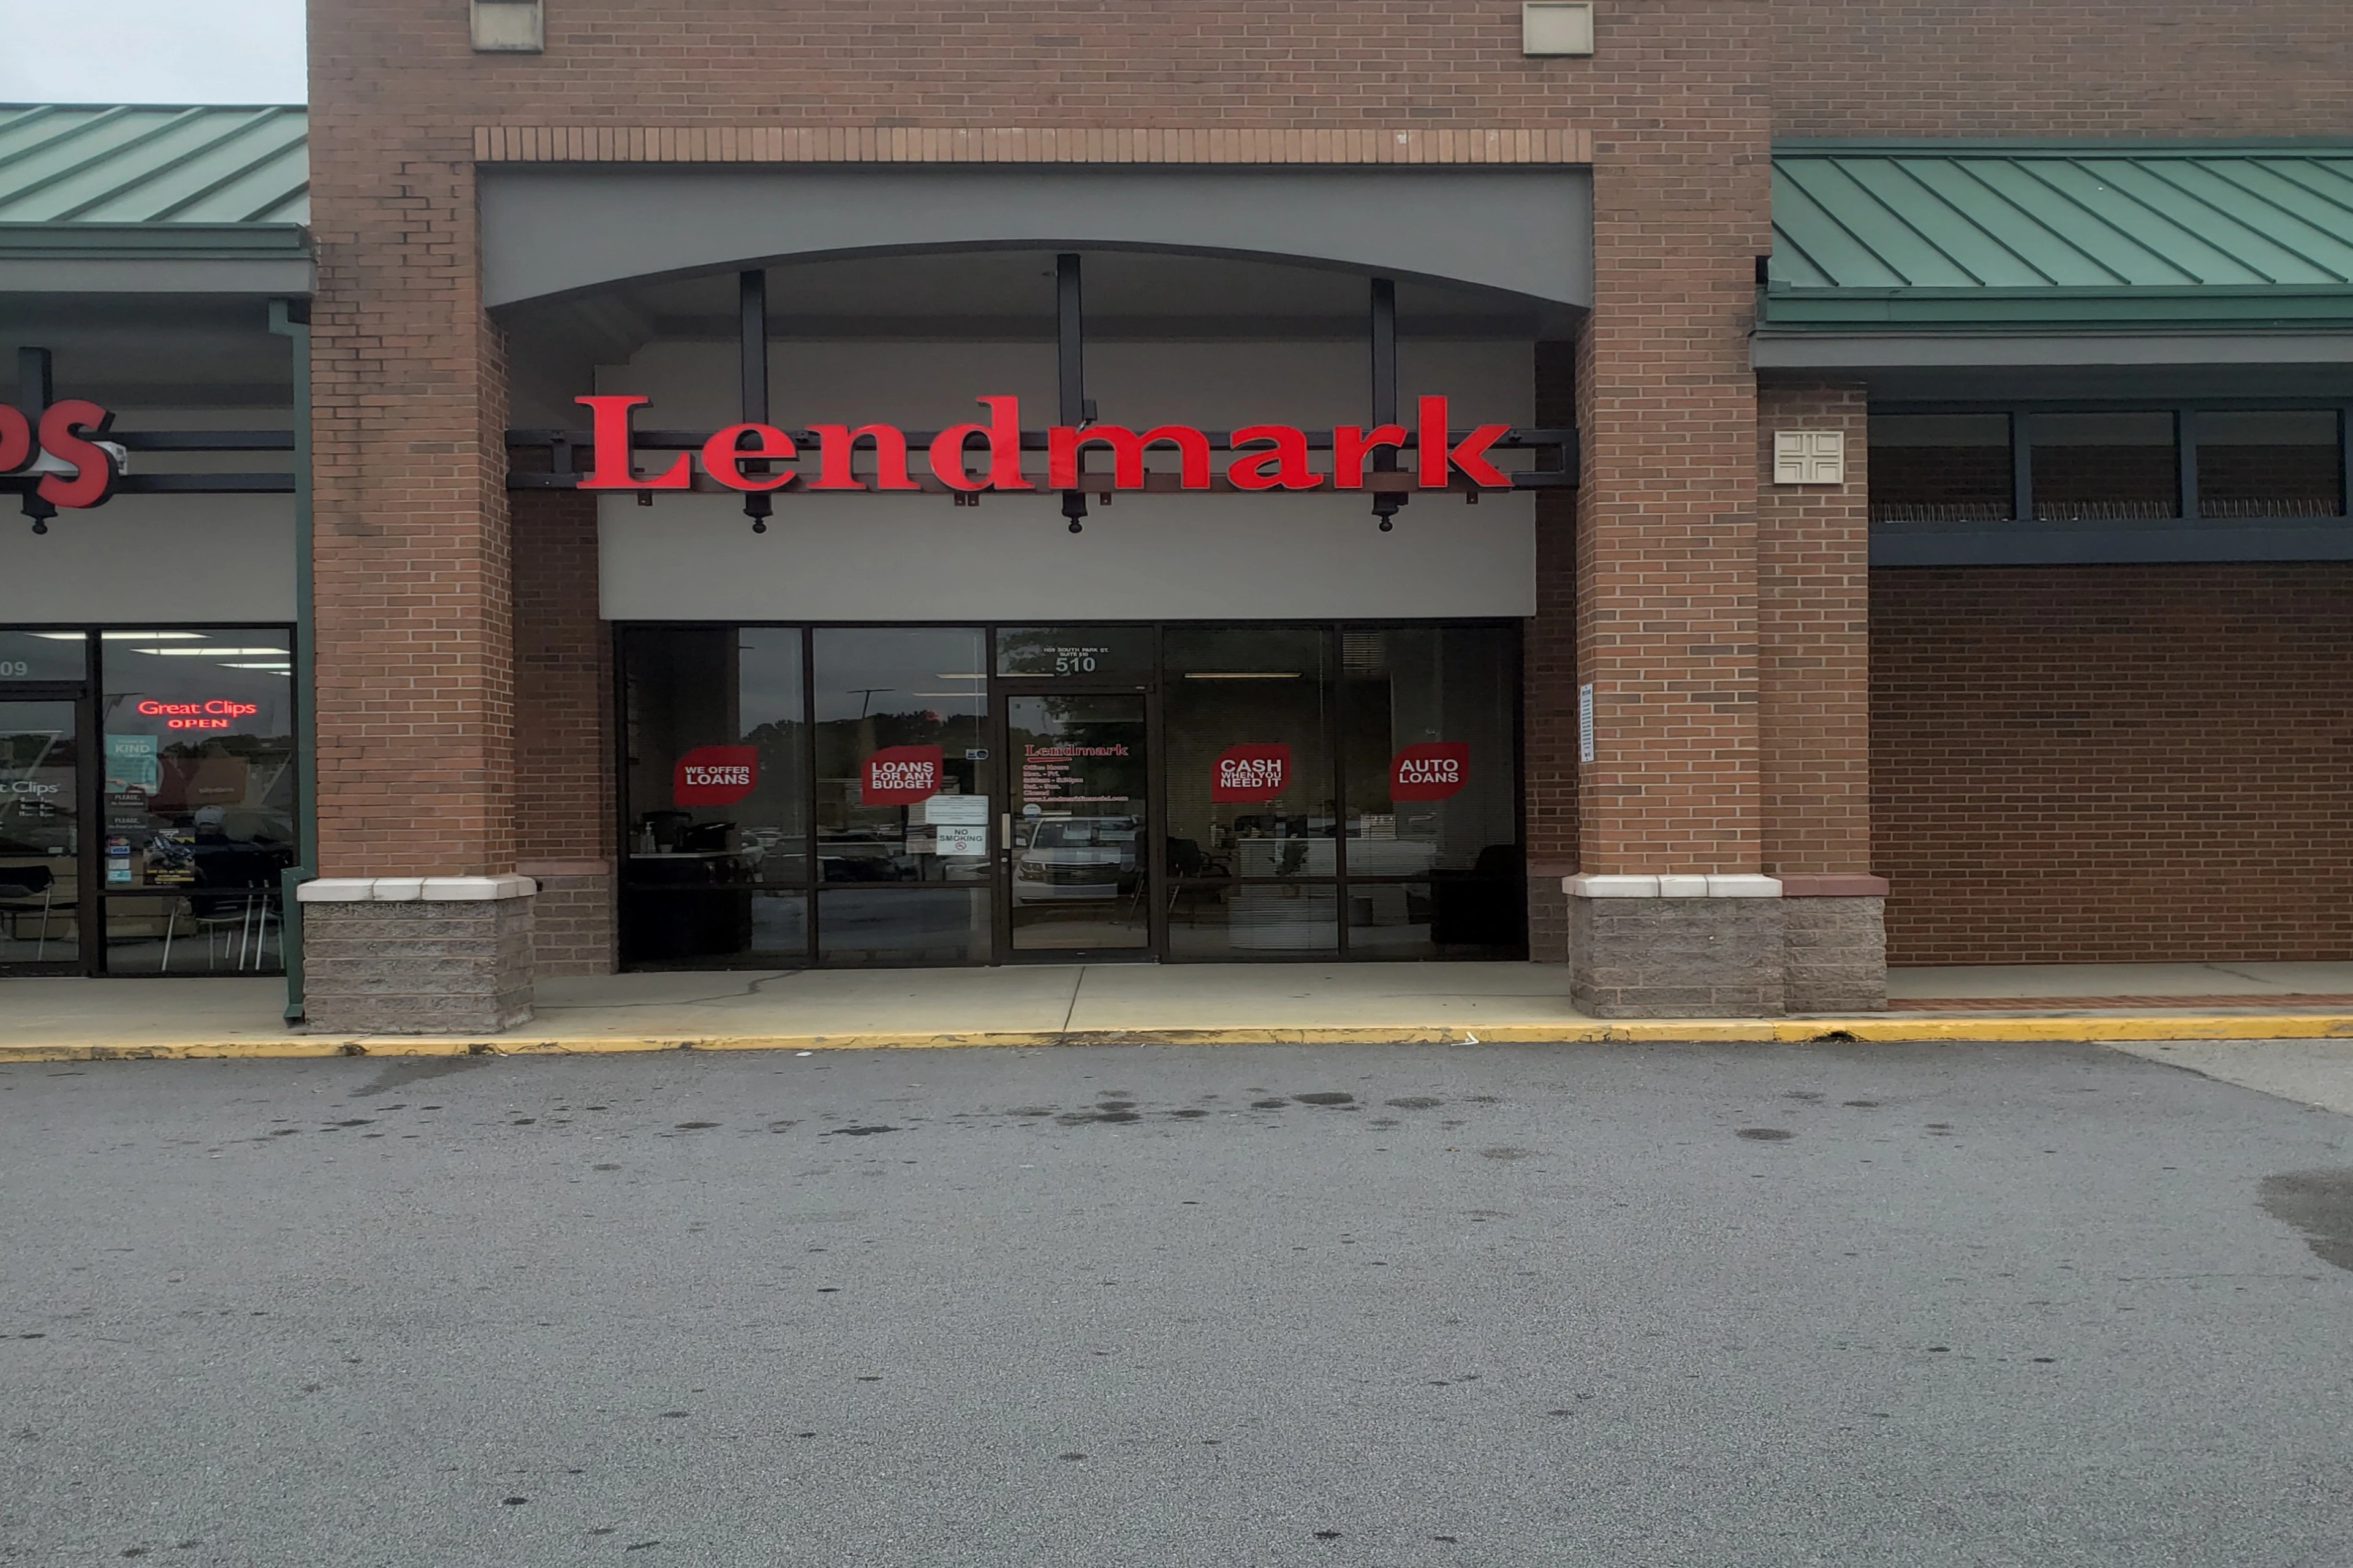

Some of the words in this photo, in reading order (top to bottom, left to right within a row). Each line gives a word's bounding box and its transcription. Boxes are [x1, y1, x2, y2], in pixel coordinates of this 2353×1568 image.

[574, 395, 1515, 491] Lendmark
[1055, 657, 1096, 672] 510
[138, 700, 202, 714] Great
[204, 700, 257, 718] Clips
[167, 719, 229, 728] OPEN
[115, 744, 151, 753] KIND
[1024, 744, 1129, 756] Lendmark
[871, 762, 934, 773] LOANS
[1221, 759, 1281, 772] CASH
[1400, 759, 1458, 772] AUTO
[686, 774, 749, 785] LOANS
[1221, 778, 1262, 787] NEED
[1267, 778, 1281, 787] IT
[1399, 772, 1459, 783] LOANS
[12, 781, 58, 797] Clips
[872, 780, 934, 789] BUDGET
